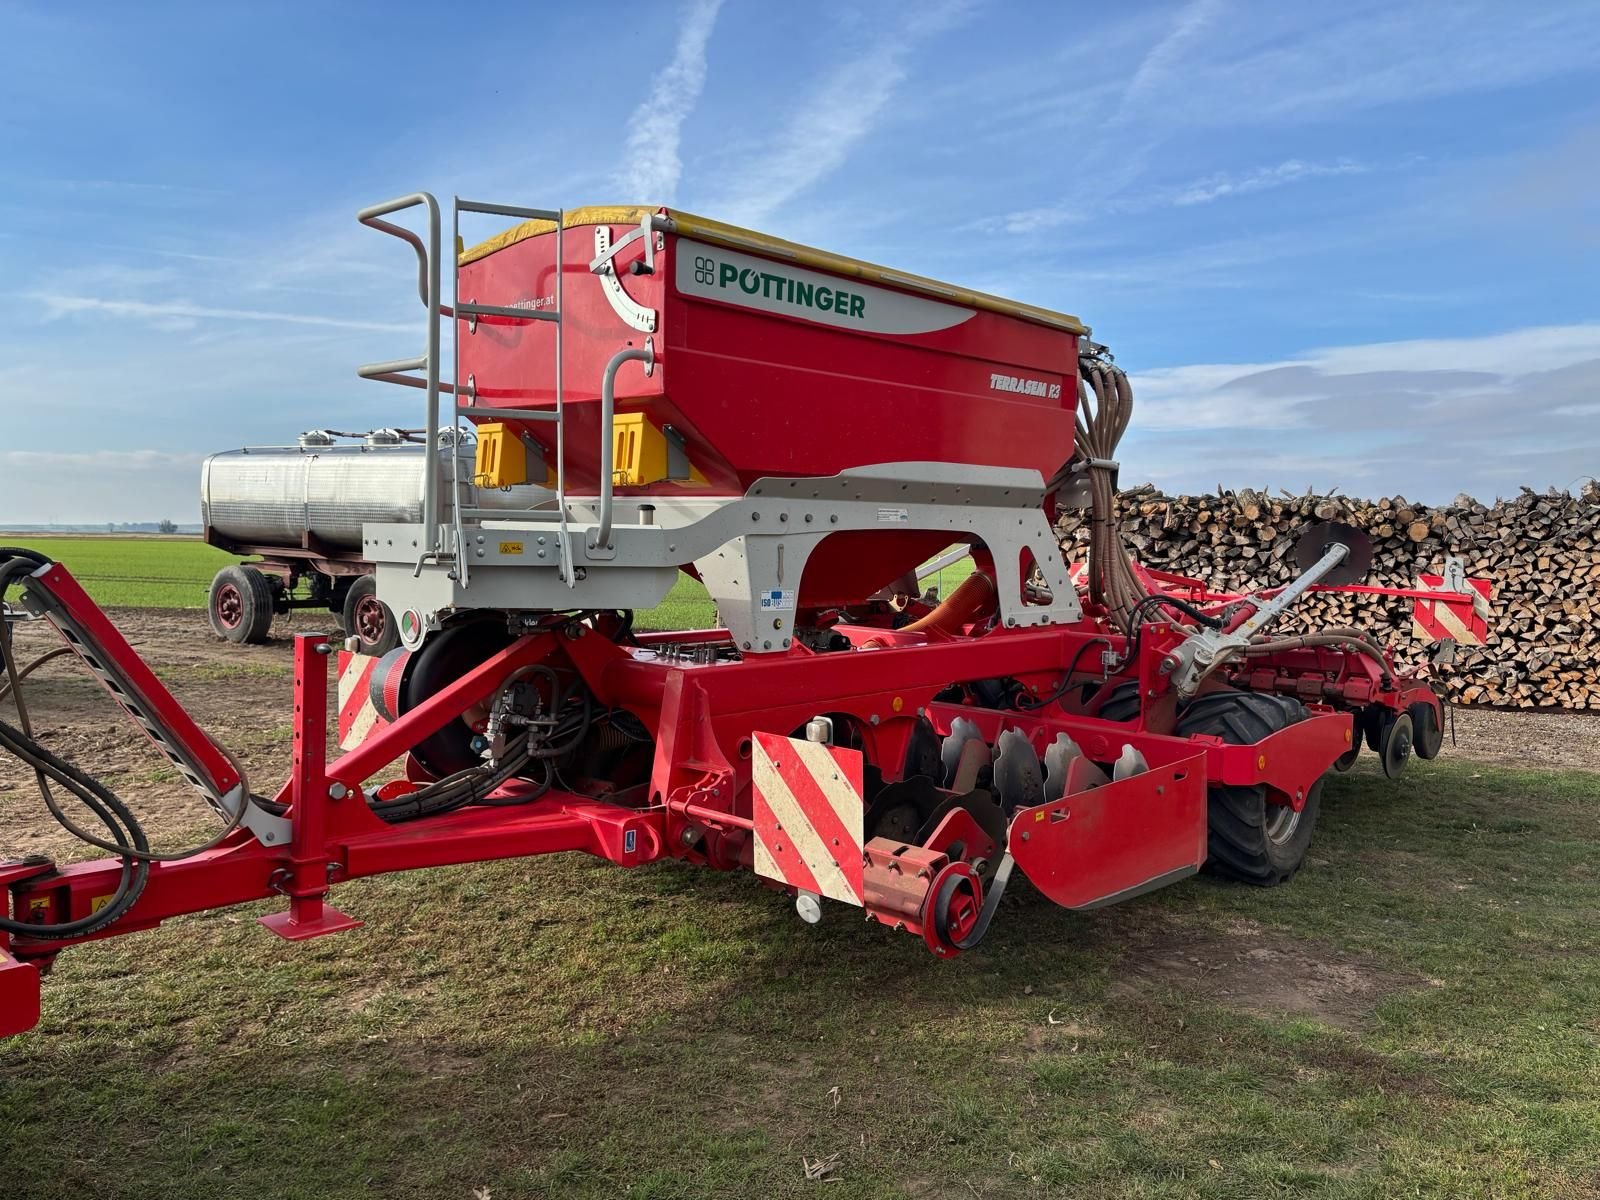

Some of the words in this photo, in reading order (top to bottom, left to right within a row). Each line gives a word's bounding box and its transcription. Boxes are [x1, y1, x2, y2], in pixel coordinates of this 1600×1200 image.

[719, 262, 866, 319] PÖTTINGER
[990, 373, 1047, 397] TERRASEM
[1047, 384, 1061, 399] R3
